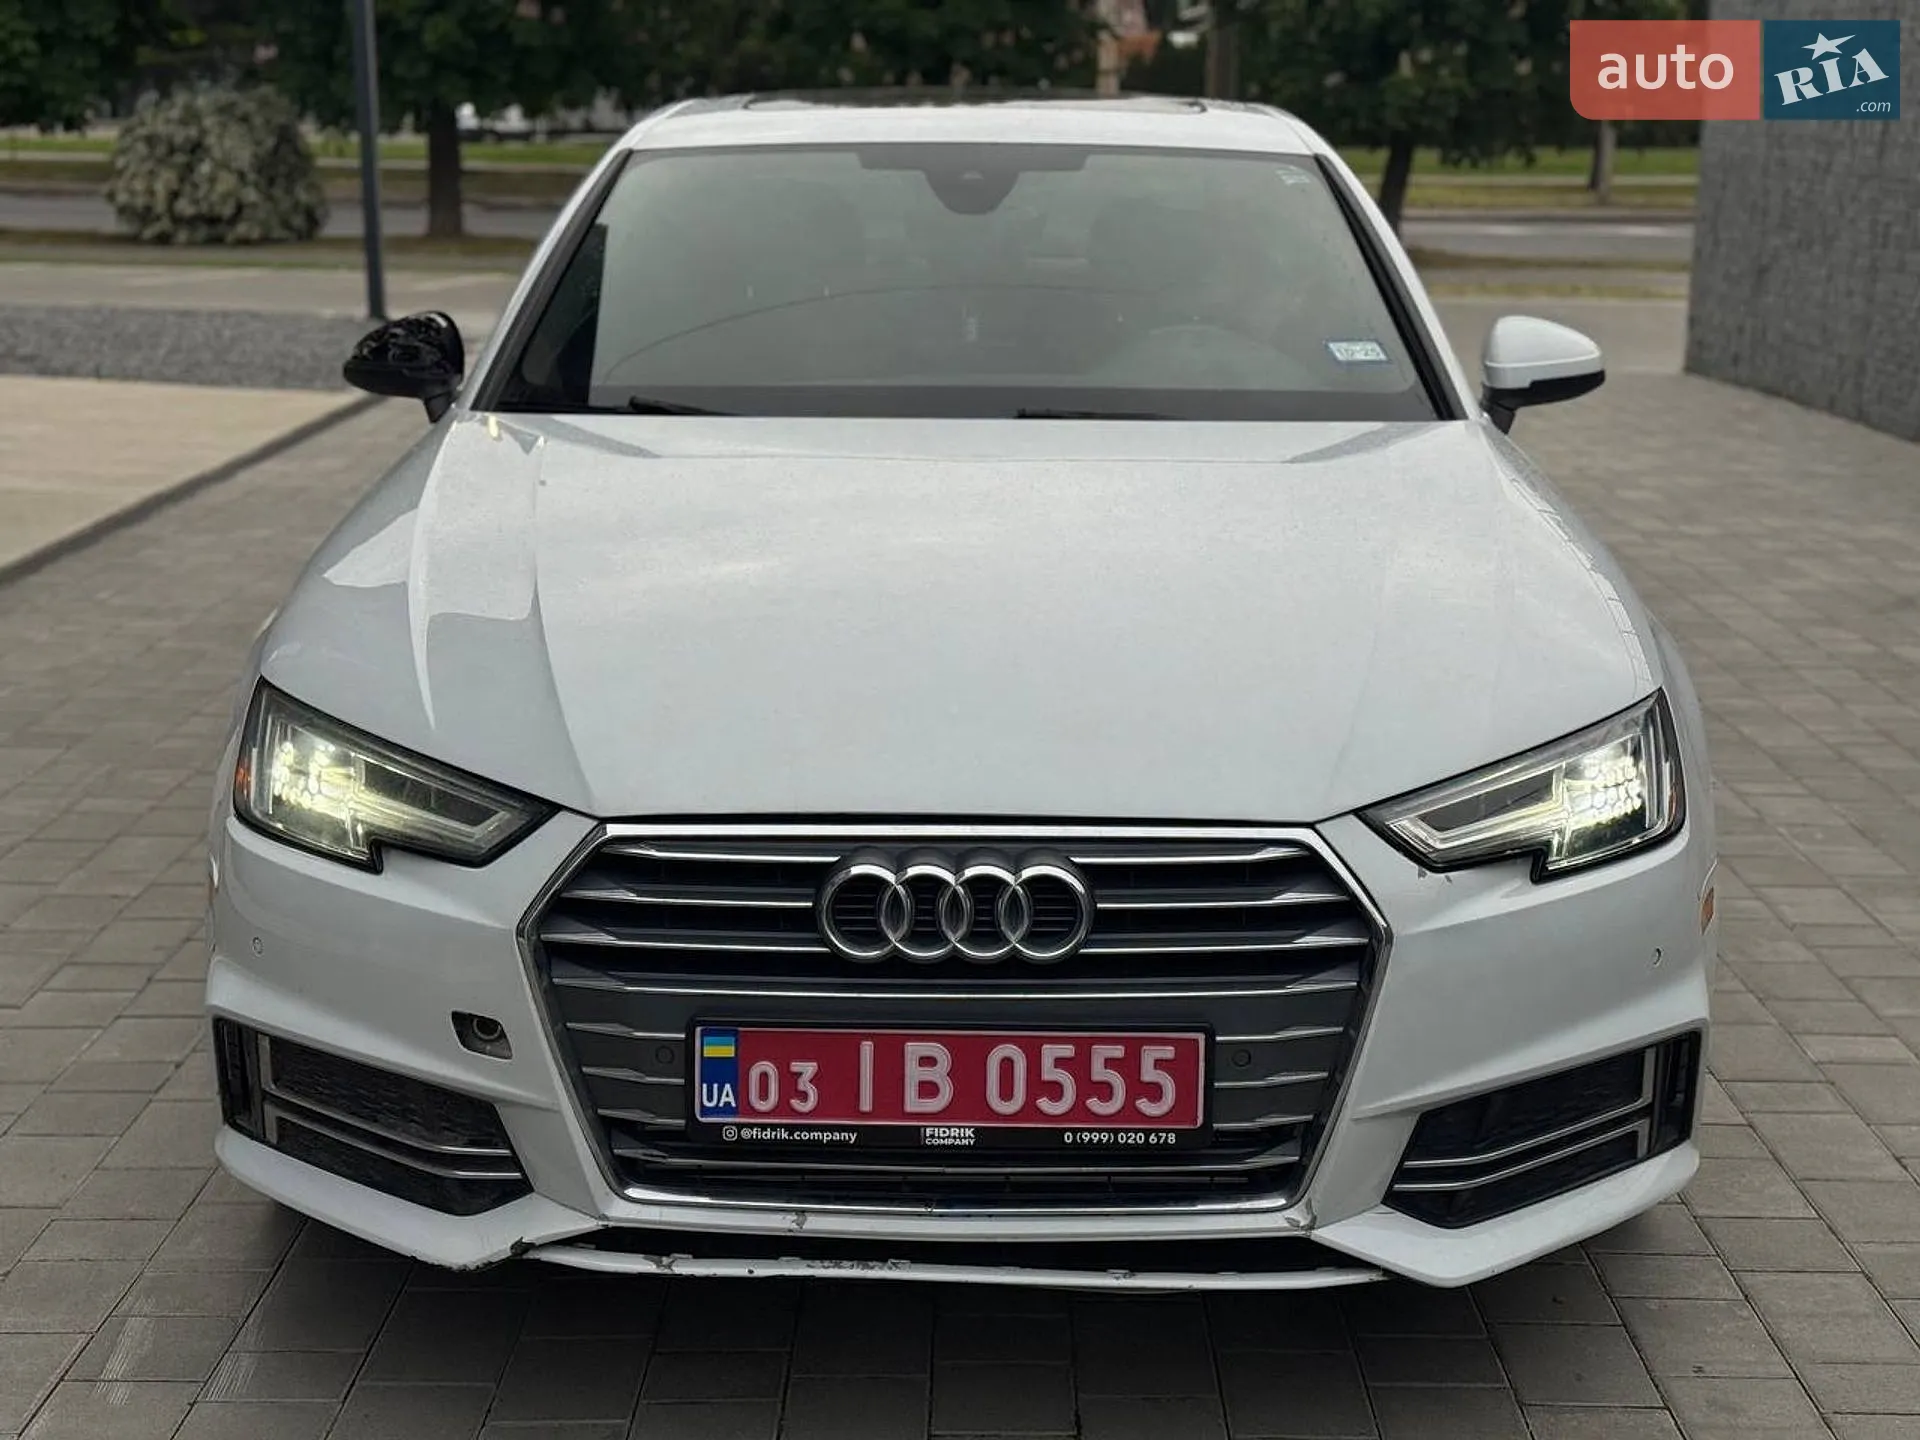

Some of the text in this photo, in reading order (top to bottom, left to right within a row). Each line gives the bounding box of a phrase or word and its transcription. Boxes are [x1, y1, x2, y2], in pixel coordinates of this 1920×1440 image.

[748, 1060, 819, 1114] 03
[986, 1043, 1177, 1117] 0555
[702, 1082, 736, 1108] UA
[740, 1127, 858, 1145] @fidrik.company
[925, 1127, 976, 1138] FIDRIK
[1063, 1131, 1177, 1145] 0 (999) 020 678
[925, 1138, 977, 1146] COMPANY
